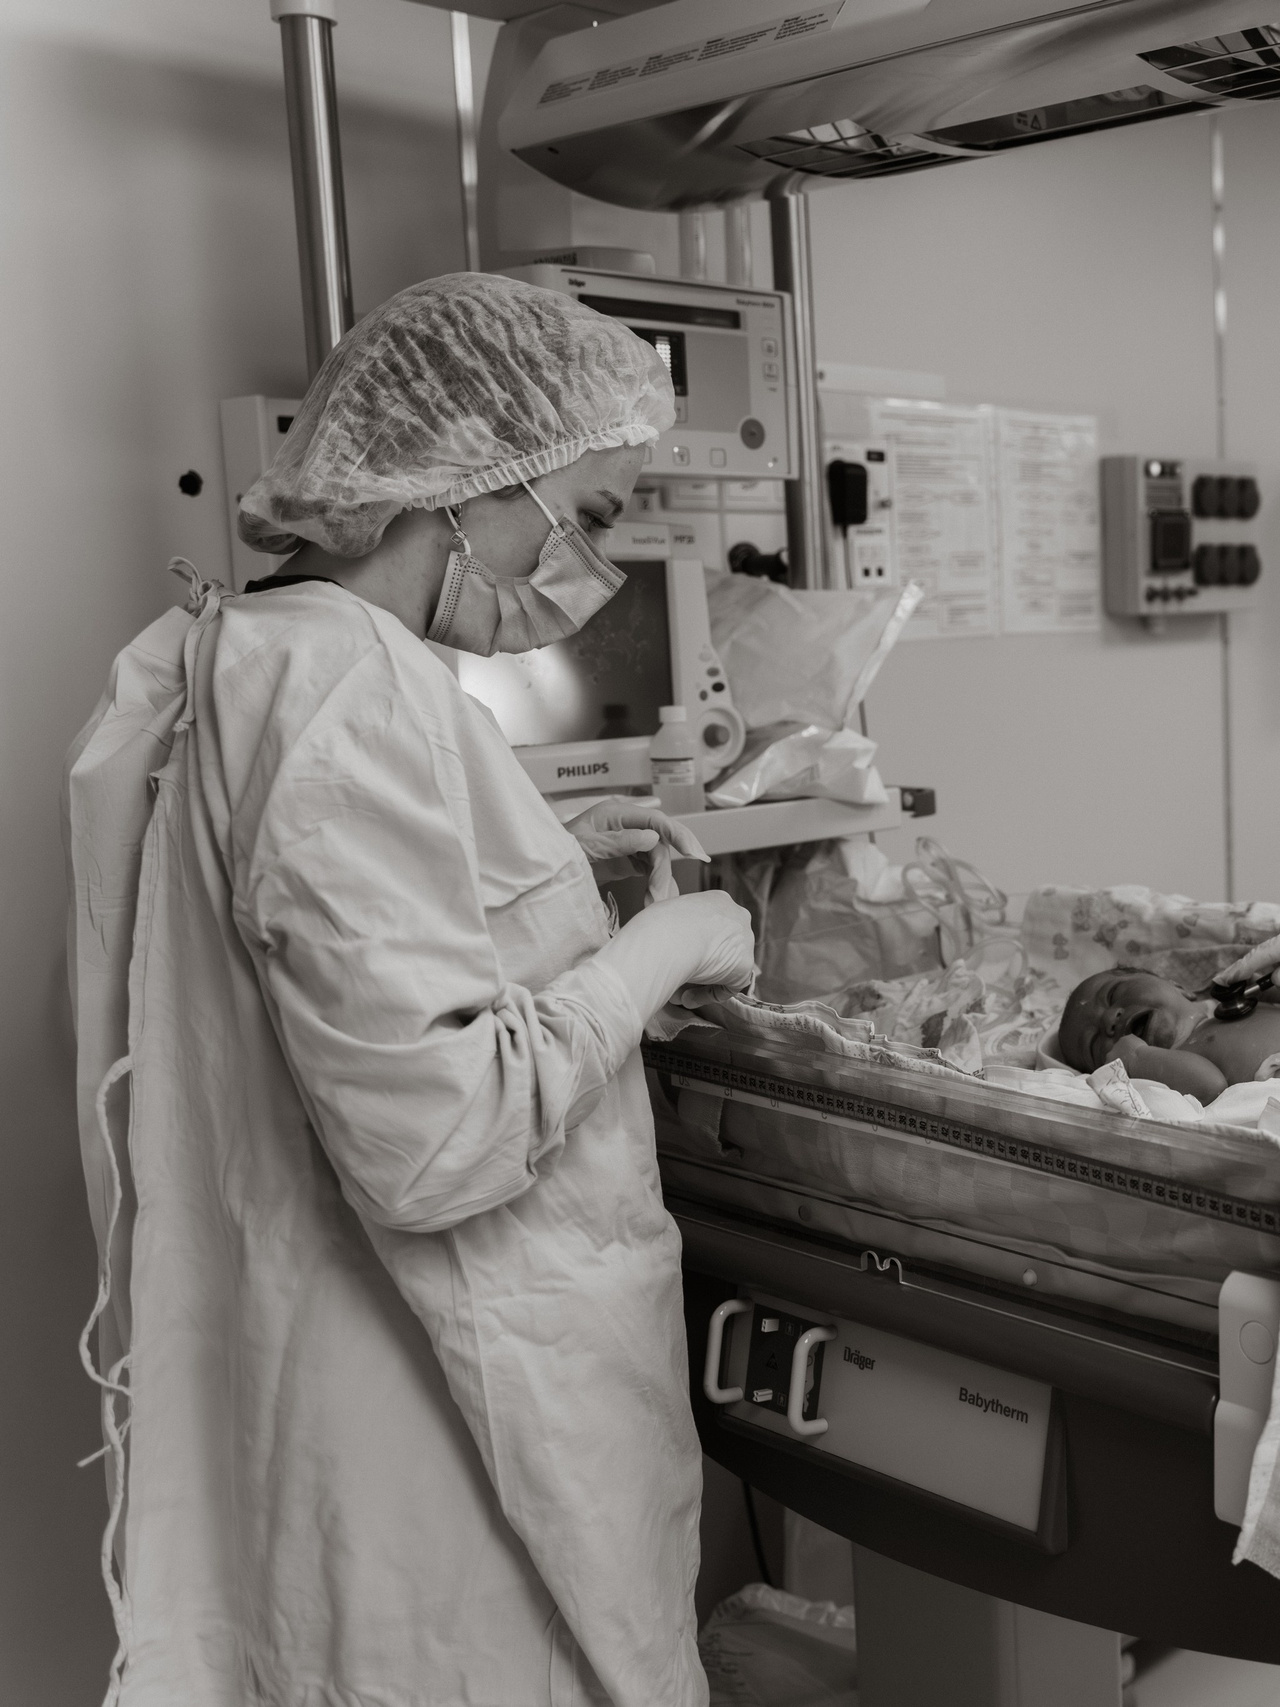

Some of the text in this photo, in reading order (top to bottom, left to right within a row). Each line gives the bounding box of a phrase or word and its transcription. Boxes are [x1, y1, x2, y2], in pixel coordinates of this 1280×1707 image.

[557, 762, 609, 778] PHILIPS
[704, 1065, 710, 1074] 18
[712, 1068, 719, 1076] 19
[722, 1070, 728, 1079] 20
[731, 1074, 738, 1082] 21
[740, 1075, 746, 1085] 22
[749, 1078, 756, 1087] 23
[759, 1080, 766, 1090] 24
[768, 1082, 776, 1092] 25
[778, 1085, 784, 1094] 26
[787, 1088, 794, 1097] 27
[797, 1090, 804, 1099] 28
[807, 1092, 814, 1102] 29
[817, 1094, 824, 1104] 30
[827, 1097, 834, 1106] 31
[837, 1100, 844, 1109] 32
[847, 1102, 854, 1111] 33
[857, 1105, 864, 1114] 34
[867, 1107, 874, 1117] 35
[877, 1110, 884, 1120] 36
[888, 1112, 896, 1122] 37
[899, 1115, 906, 1125] 38
[909, 1118, 916, 1128] 39
[920, 1121, 927, 1131] 40
[930, 1124, 938, 1134] 41
[941, 1127, 949, 1137] 42
[952, 1130, 960, 1140] 43
[964, 1133, 972, 1143] 44
[975, 1136, 983, 1146] 45
[986, 1140, 995, 1150] 46
[998, 1142, 1006, 1153] 47
[1009, 1146, 1017, 1156] 48
[1020, 1149, 1029, 1159] 49
[1033, 1152, 1041, 1162] 50
[1044, 1156, 1053, 1166] 51
[1056, 1159, 1064, 1170] 52
[1068, 1162, 1077, 1173] 53
[1080, 1166, 1089, 1176] 54
[1092, 1169, 1101, 1180] 55
[1105, 1172, 1114, 1183] 56
[1117, 1175, 1126, 1186] 57
[1130, 1179, 1139, 1190] 58
[1142, 1182, 1152, 1193] 59
[1156, 1186, 1165, 1197] 60
[1169, 1190, 1178, 1200] 61
[1182, 1193, 1192, 1204] 62
[843, 1346, 876, 1371] Dräger
[958, 1387, 1029, 1424] Babytherm
